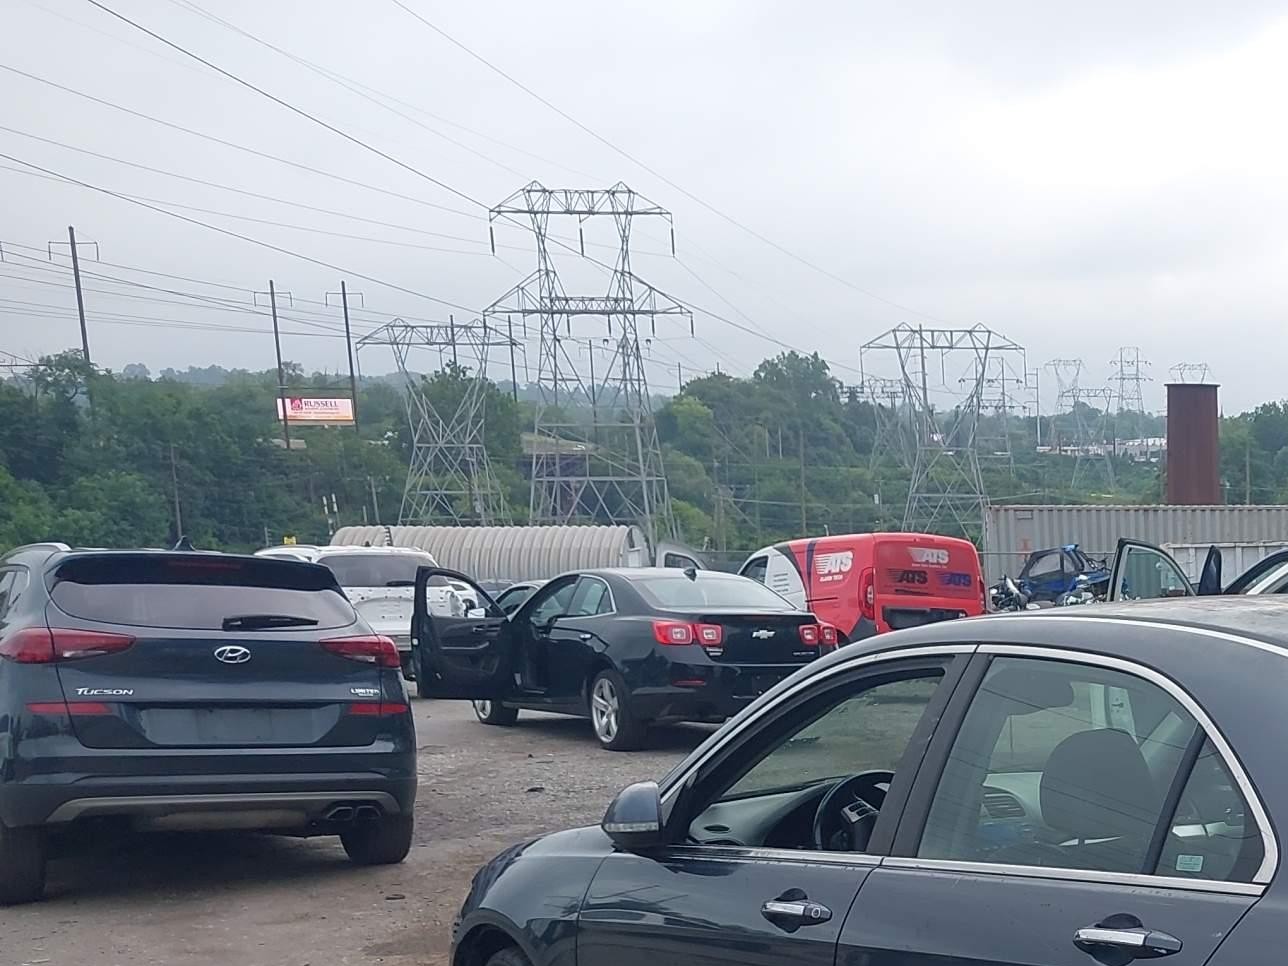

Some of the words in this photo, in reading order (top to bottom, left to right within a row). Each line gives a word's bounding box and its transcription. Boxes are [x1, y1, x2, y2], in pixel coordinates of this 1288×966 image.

[822, 551, 853, 574] ATS
[919, 547, 949, 564] ATS
[895, 569, 928, 585] ATS
[943, 572, 972, 586] ATS
[75, 687, 133, 695] TUCSON
